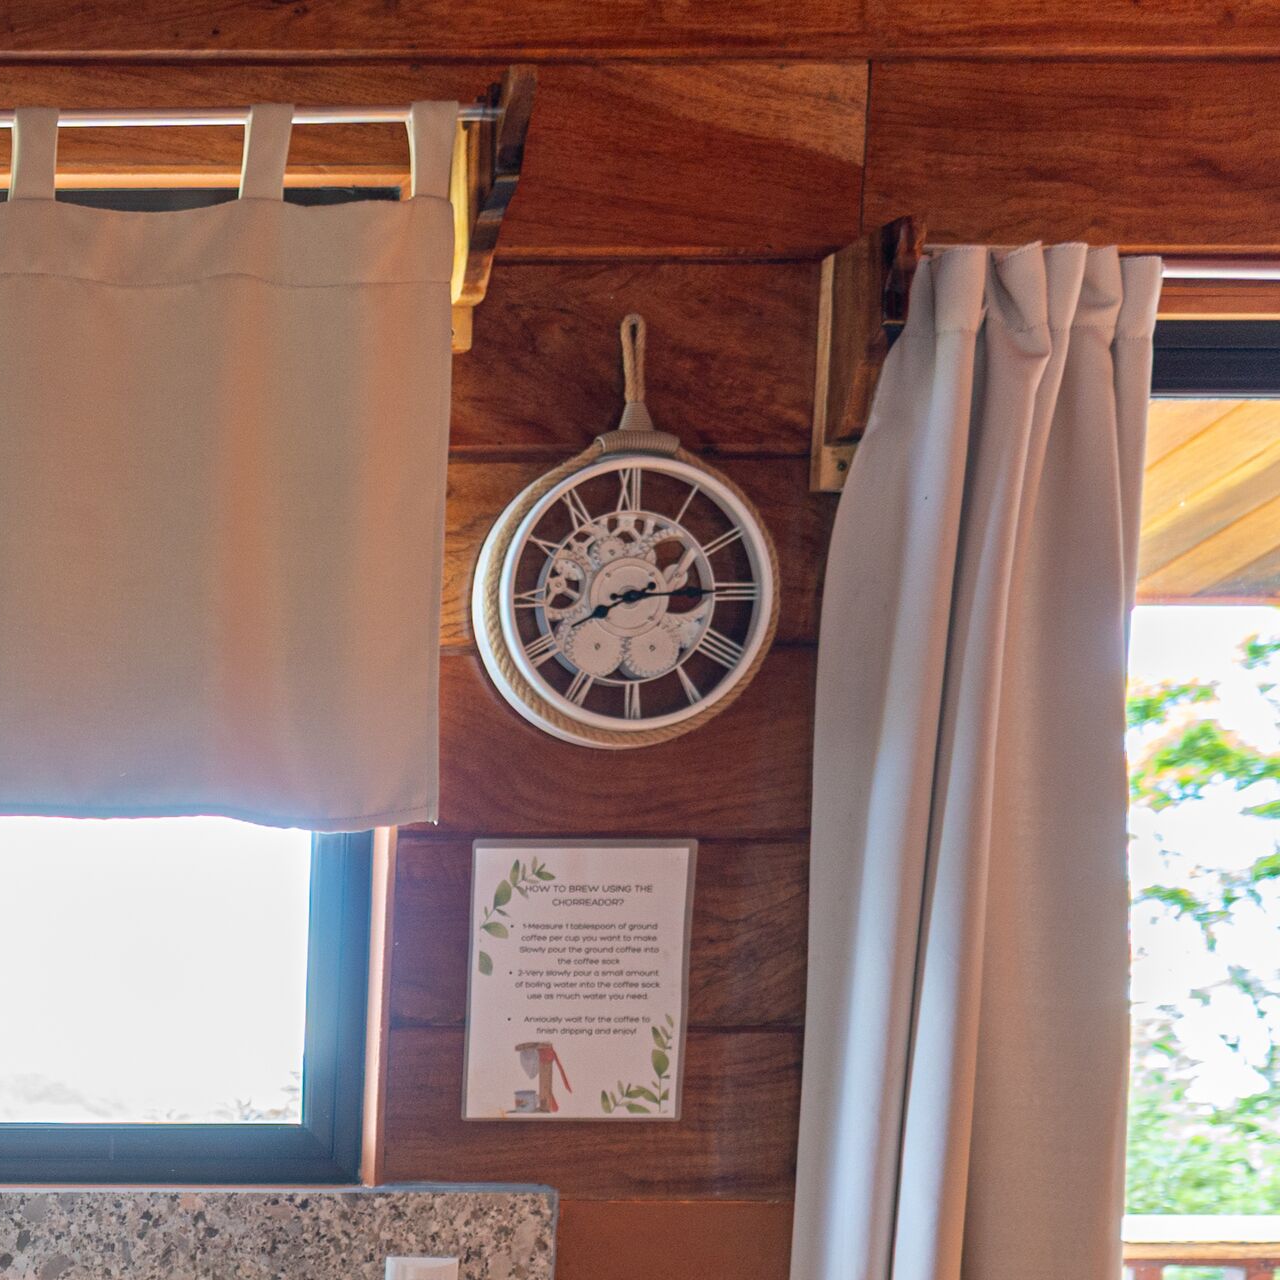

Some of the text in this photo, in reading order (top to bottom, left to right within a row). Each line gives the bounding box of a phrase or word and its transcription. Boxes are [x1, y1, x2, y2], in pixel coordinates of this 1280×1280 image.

[525, 885, 653, 893] HOW TO BREW USING THE
[552, 898, 624, 907] CHORREADOR?
[570, 923, 616, 931] tablespoon
[628, 923, 658, 931] ground
[520, 946, 546, 954] Slowly
[584, 946, 614, 954] ground
[525, 981, 551, 989] boiling
[524, 1016, 562, 1024] Anxiously
[560, 1027, 593, 1036] dripping
